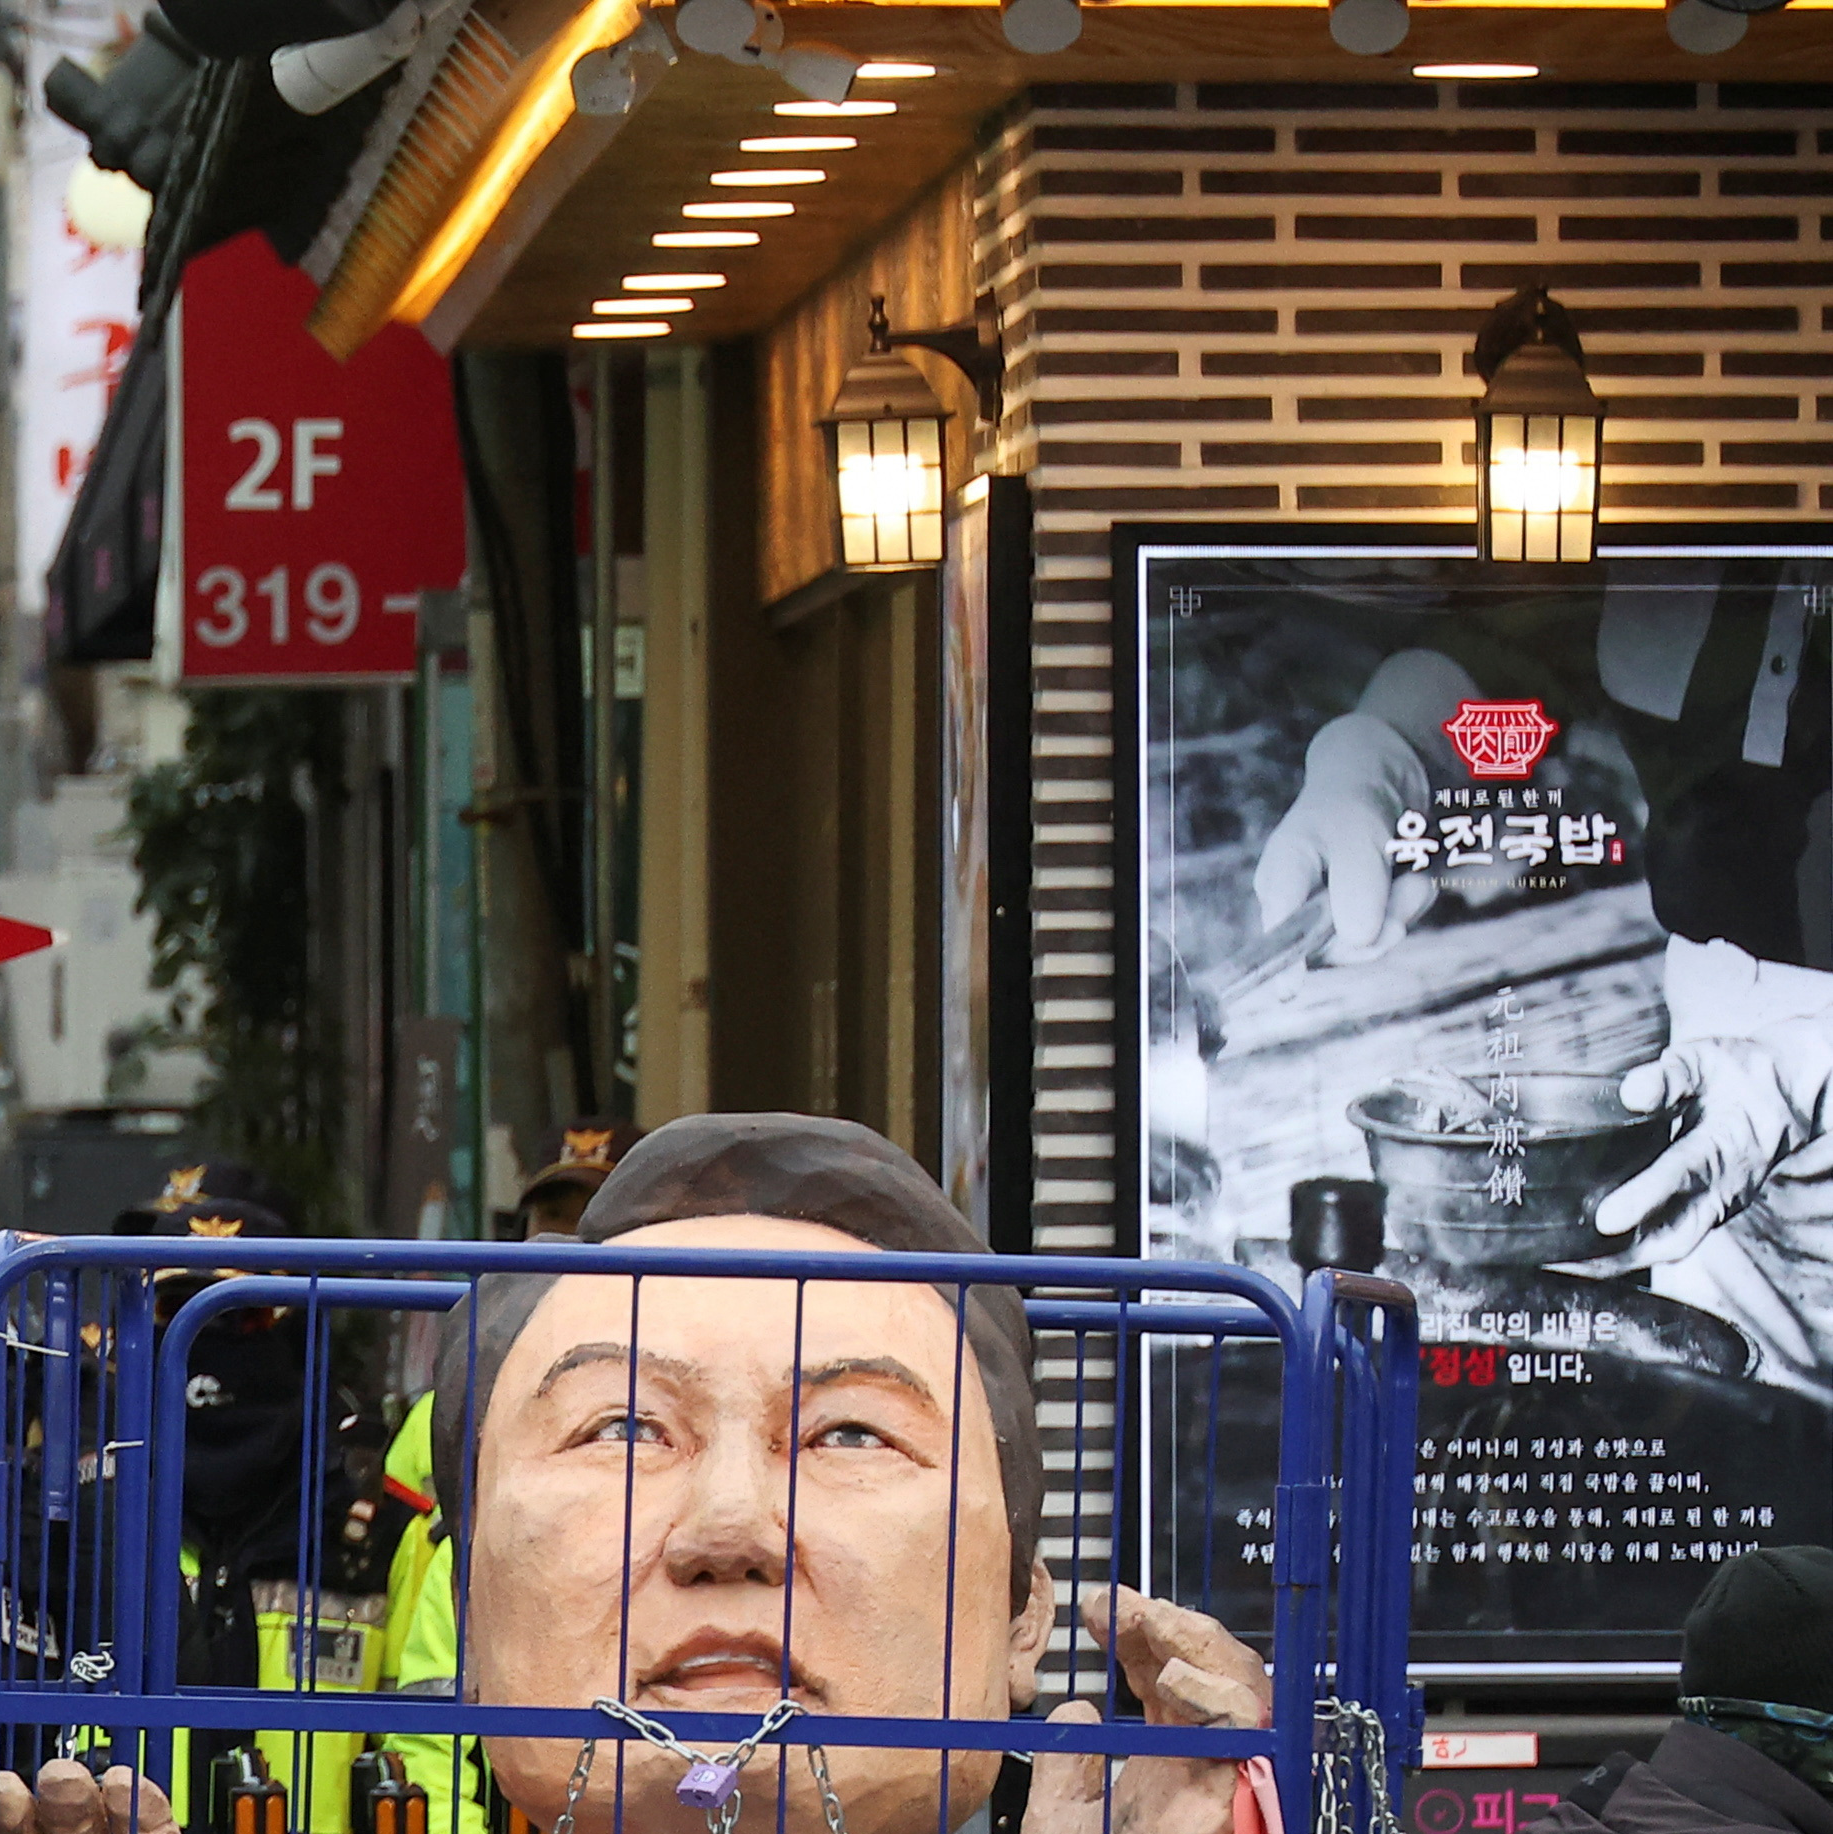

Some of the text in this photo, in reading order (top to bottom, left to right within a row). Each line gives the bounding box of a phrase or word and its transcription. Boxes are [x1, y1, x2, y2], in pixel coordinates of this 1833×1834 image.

[225, 419, 344, 514] 2F
[1434, 788, 1491, 808] 제대로
[1521, 788, 1540, 808] 한
[1546, 788, 1563, 808] 끼
[1384, 809, 1617, 872] 육전국밥
[1419, 1311, 1618, 1344] 리집 맛의 비밀은
[1506, 1352, 1593, 1384] 입니다.
[1446, 1437, 1519, 1460] 어머니의
[1530, 1437, 1584, 1460] 정성과
[1593, 1437, 1667, 1460] 손맛으로
[1456, 1472, 1528, 1495] 매장에서
[1539, 1471, 1575, 1494] 직접
[1584, 1471, 1639, 1495] 국밥을
[1567, 1506, 1612, 1529] 통해,
[1621, 1506, 1677, 1529] 제대로
[1685, 1506, 1703, 1529] 된
[1712, 1506, 1731, 1529] 한
[1739, 1506, 1775, 1528] 끼를
[1449, 1542, 1487, 1564] 함께
[1496, 1541, 1551, 1565] 행복한
[1560, 1541, 1615, 1565] 식당을
[1624, 1540, 1661, 1564] 위해
